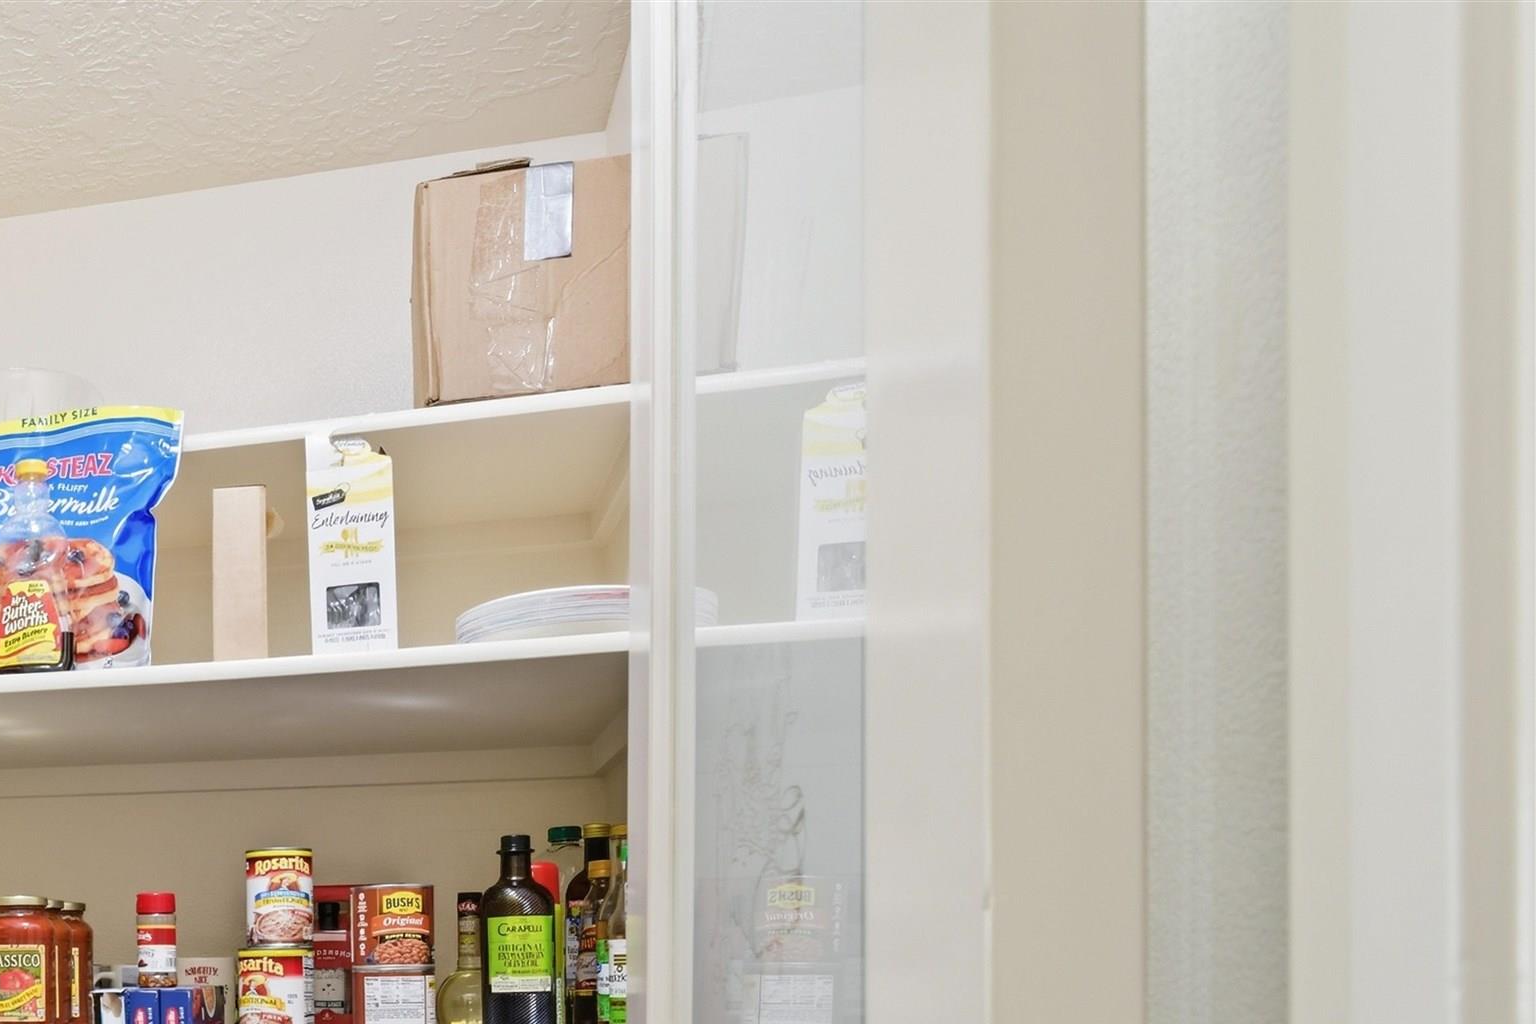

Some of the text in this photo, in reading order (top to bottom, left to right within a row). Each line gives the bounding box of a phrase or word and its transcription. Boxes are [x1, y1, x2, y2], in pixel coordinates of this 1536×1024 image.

[21, 407, 98, 428] FAMILY SIZE
[311, 509, 390, 531] Entertaining
[254, 856, 311, 876] Rosarita
[385, 897, 421, 910] BUSH'S
[382, 915, 424, 927] Original
[497, 922, 544, 937] CARAPELLI
[497, 943, 545, 952] ORIGINAL
